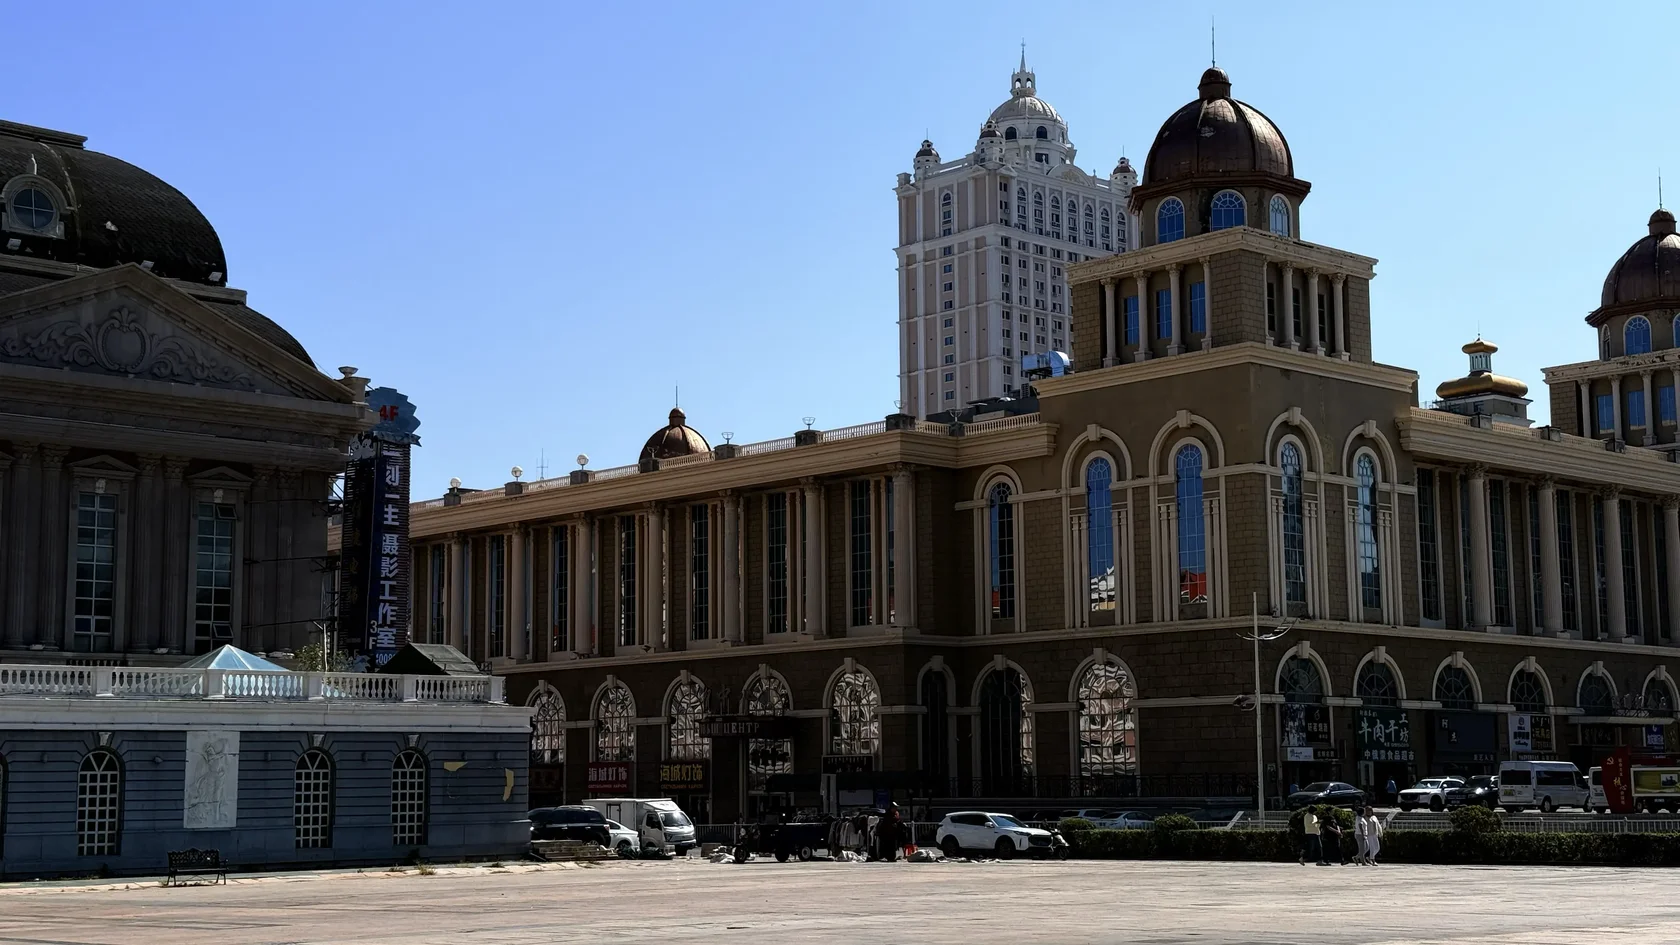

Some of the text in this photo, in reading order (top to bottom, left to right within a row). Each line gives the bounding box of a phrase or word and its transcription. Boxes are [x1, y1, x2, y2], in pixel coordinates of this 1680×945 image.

[380, 404, 399, 421] 4F
[1358, 717, 1399, 744] 牛肉干
